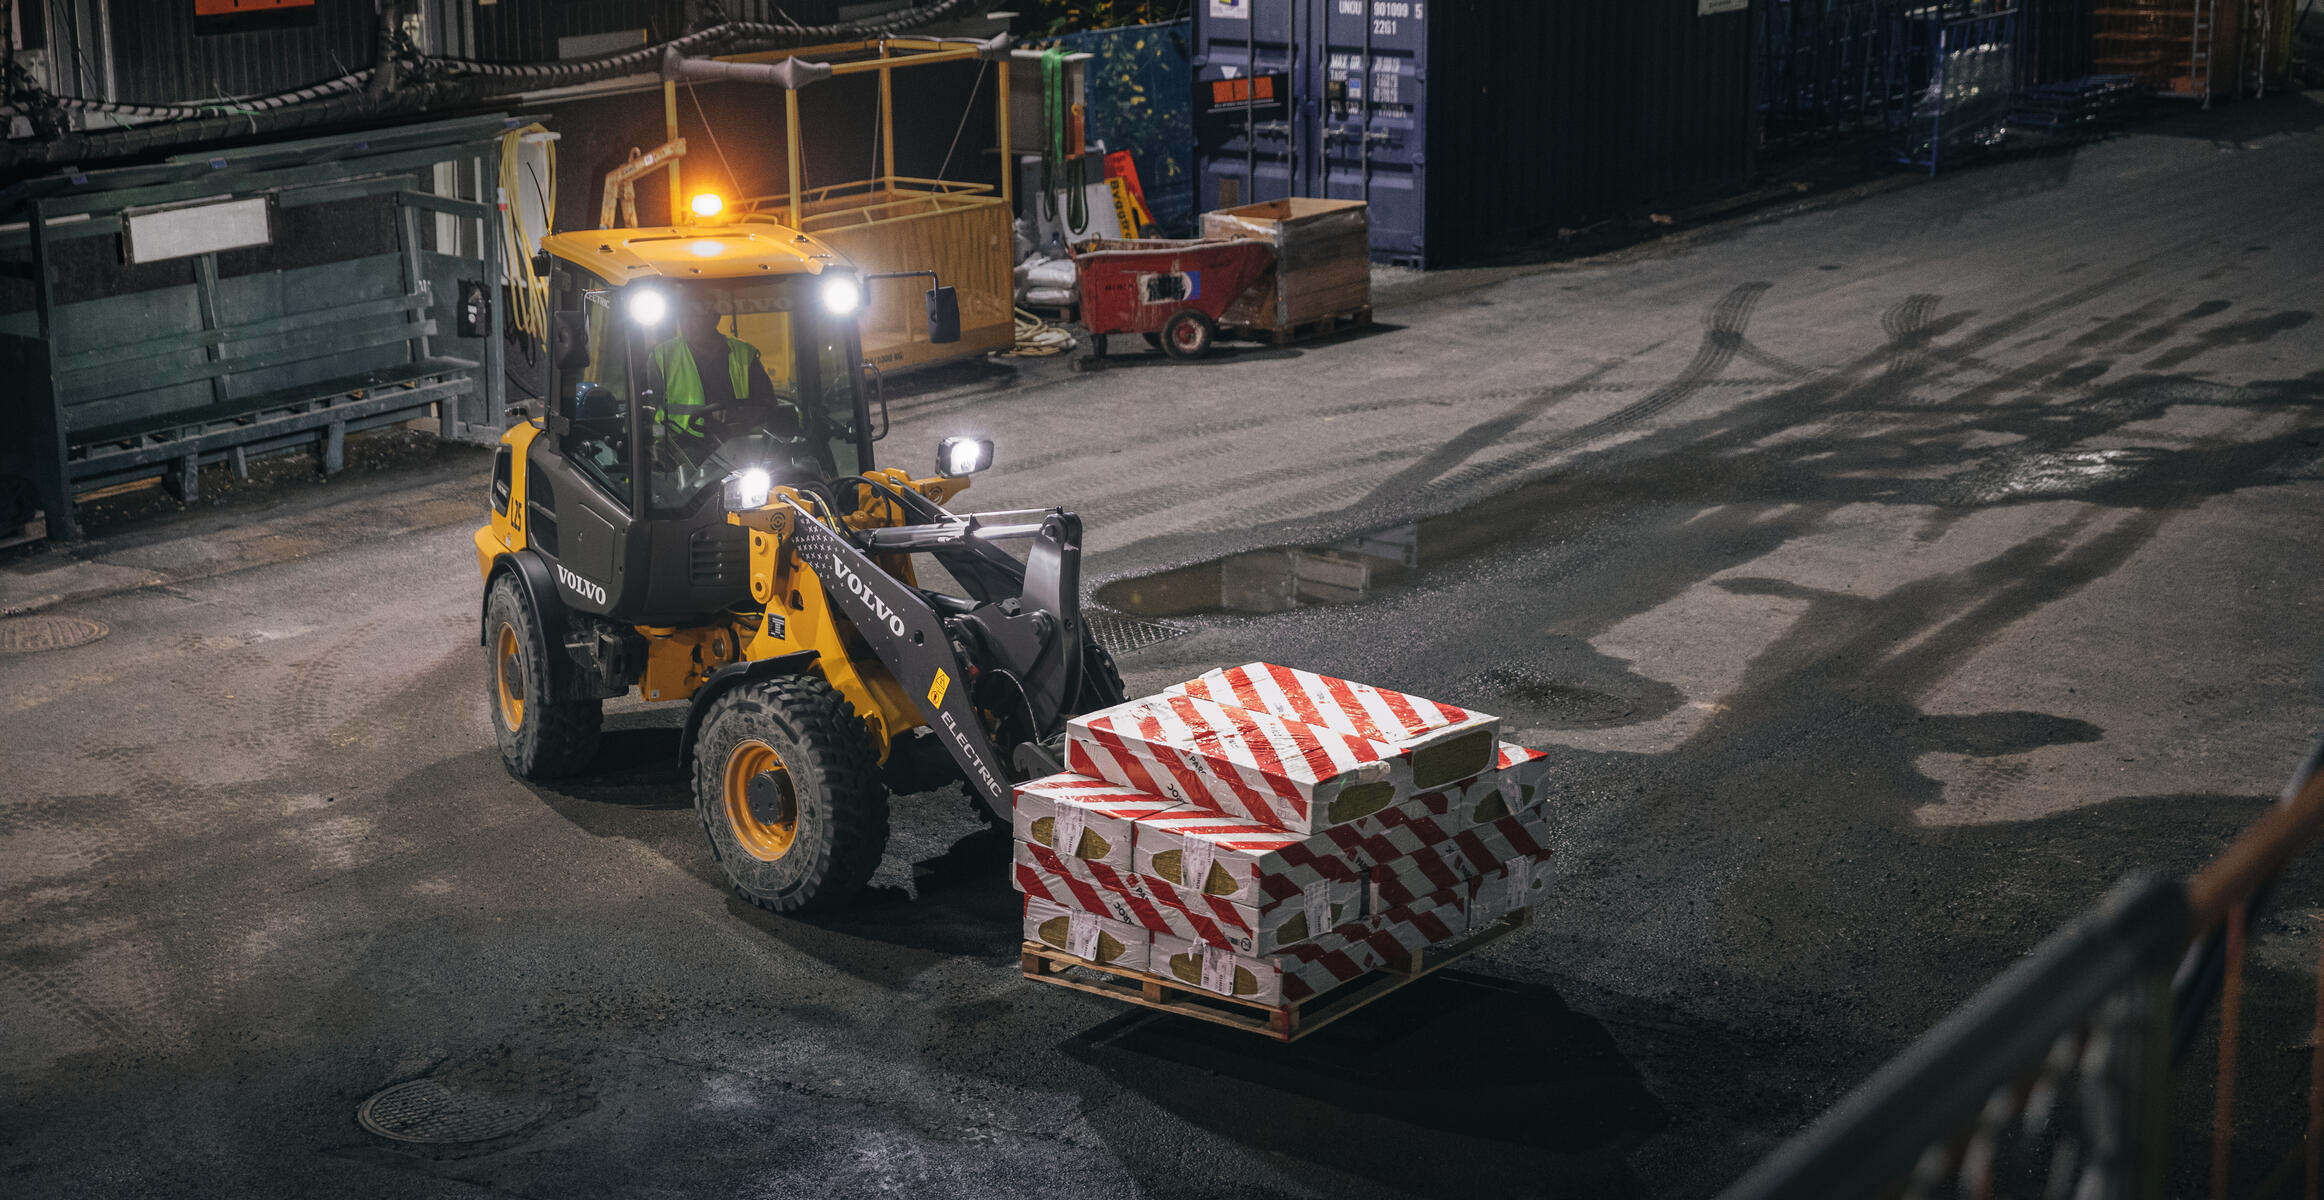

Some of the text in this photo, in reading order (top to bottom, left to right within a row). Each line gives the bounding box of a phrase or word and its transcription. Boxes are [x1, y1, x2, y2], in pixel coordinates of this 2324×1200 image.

[511, 497, 522, 532] L25
[557, 564, 606, 606] VOLVO
[832, 553, 905, 637] VOLVO
[940, 711, 1002, 798] ELECTRIC
